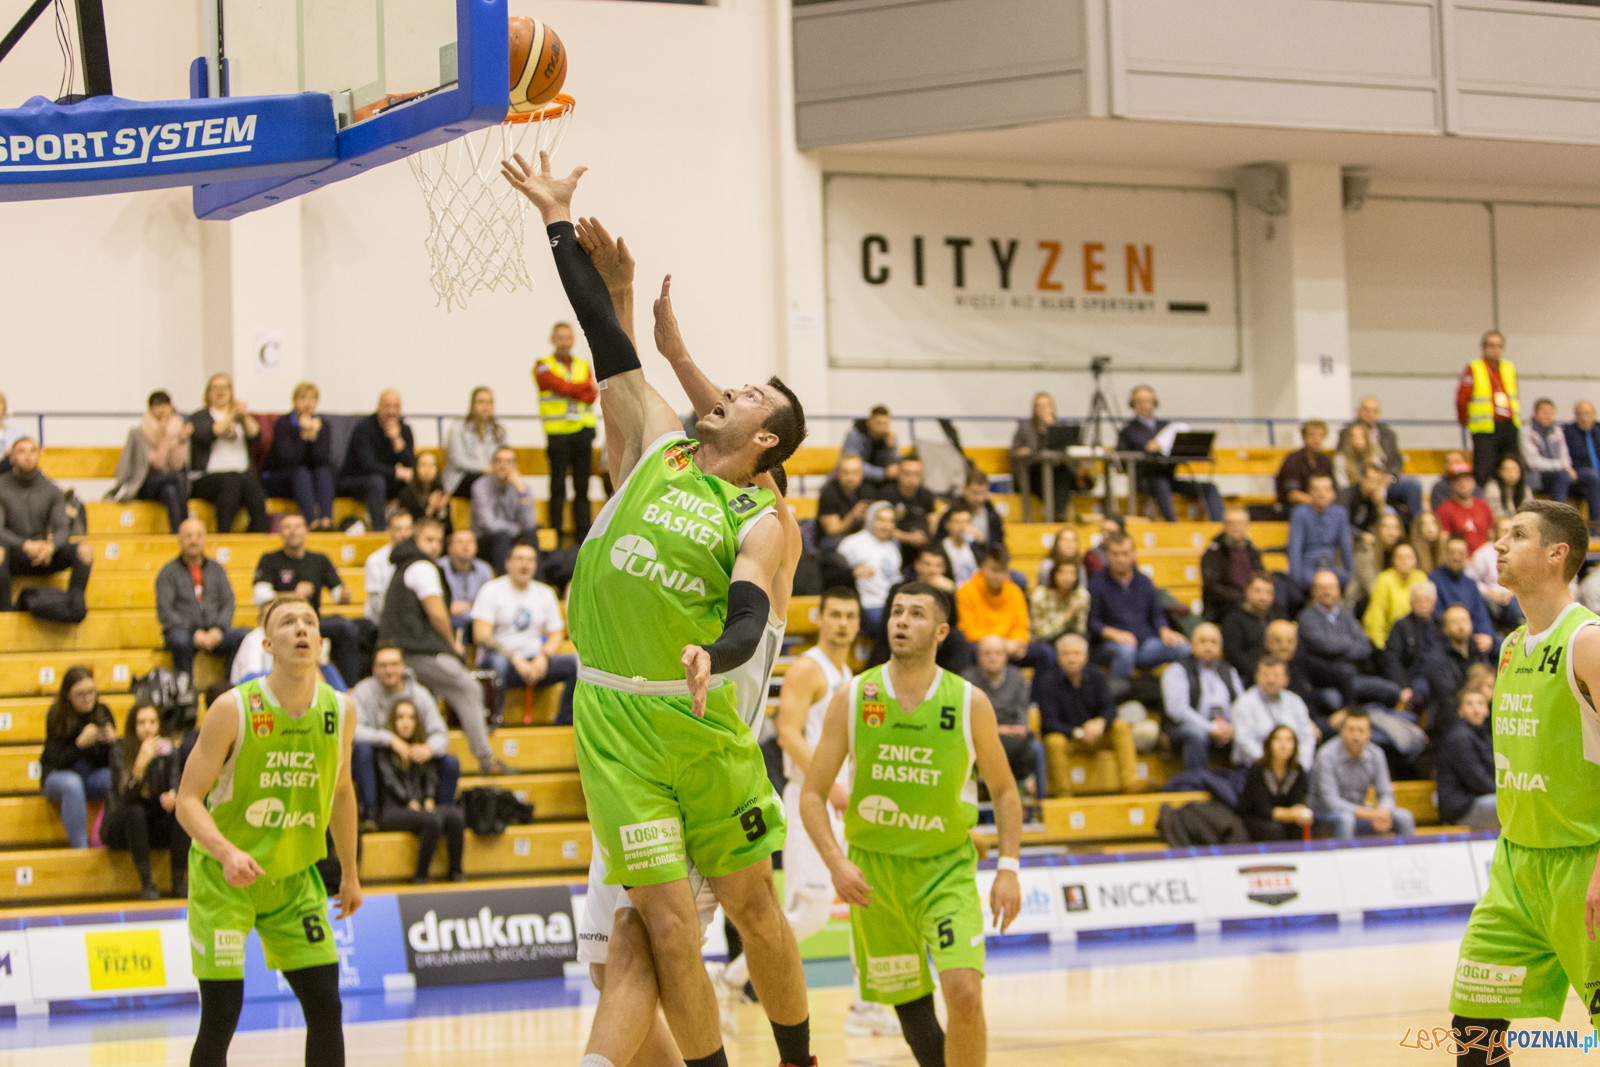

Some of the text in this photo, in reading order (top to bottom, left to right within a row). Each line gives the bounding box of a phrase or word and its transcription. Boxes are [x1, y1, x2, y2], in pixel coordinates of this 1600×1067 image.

[861, 233, 1155, 294] CITYZEN
[660, 484, 725, 526] ZNICZ
[728, 493, 758, 514] 9
[642, 504, 723, 551] BASKET
[625, 554, 706, 598] UNIA
[1538, 645, 1563, 674] 14
[1499, 693, 1534, 712] ZNICZ
[324, 711, 335, 735] 6
[940, 706, 956, 731] 5
[265, 751, 315, 769] ZNICZ
[877, 744, 934, 765] ZNICZ
[872, 763, 942, 787] BASKET
[625, 826, 659, 845] LOGO
[740, 807, 767, 842] 9
[877, 810, 945, 833] UNIA
[1100, 879, 1198, 909] NICKEL
[302, 915, 325, 943] 6
[408, 906, 573, 952] drukma
[938, 918, 955, 949] 5
